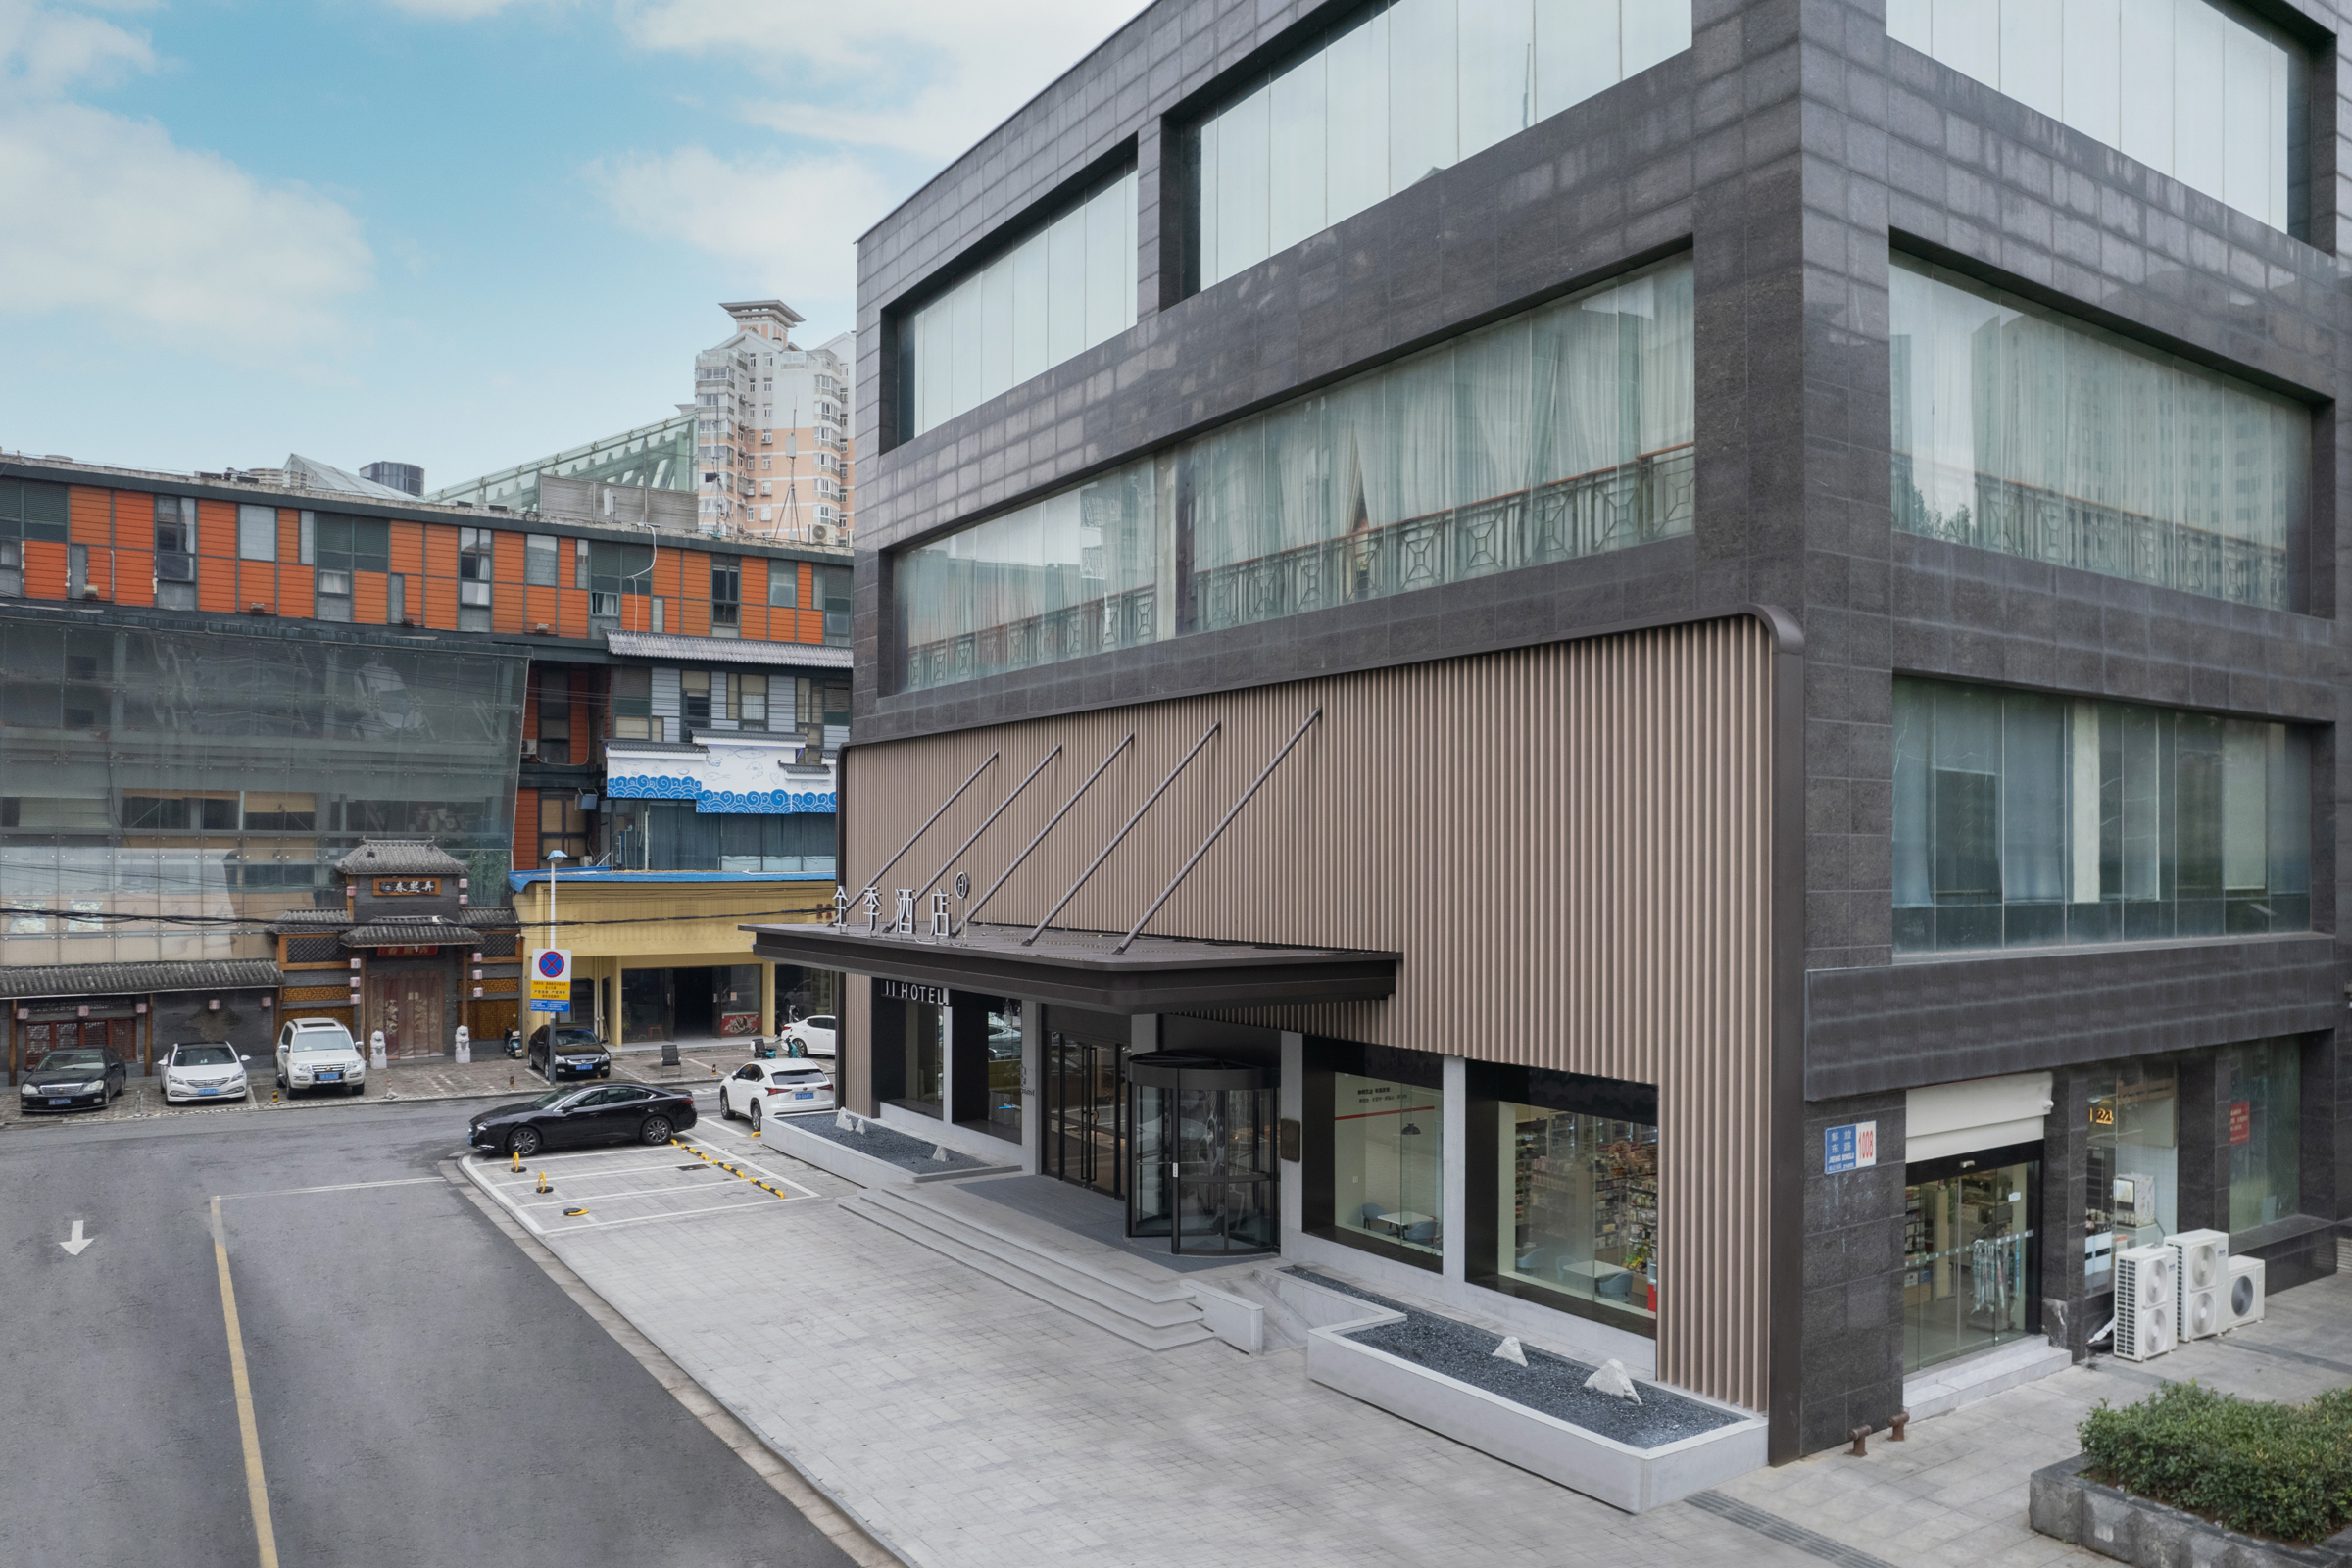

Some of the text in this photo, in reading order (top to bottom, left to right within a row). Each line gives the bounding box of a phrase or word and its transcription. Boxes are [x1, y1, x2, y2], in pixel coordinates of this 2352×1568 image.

[832, 886, 952, 937] 全季酒店
[885, 980, 945, 1005] JI HOTEL
[1858, 1130, 1874, 1160] 1008
